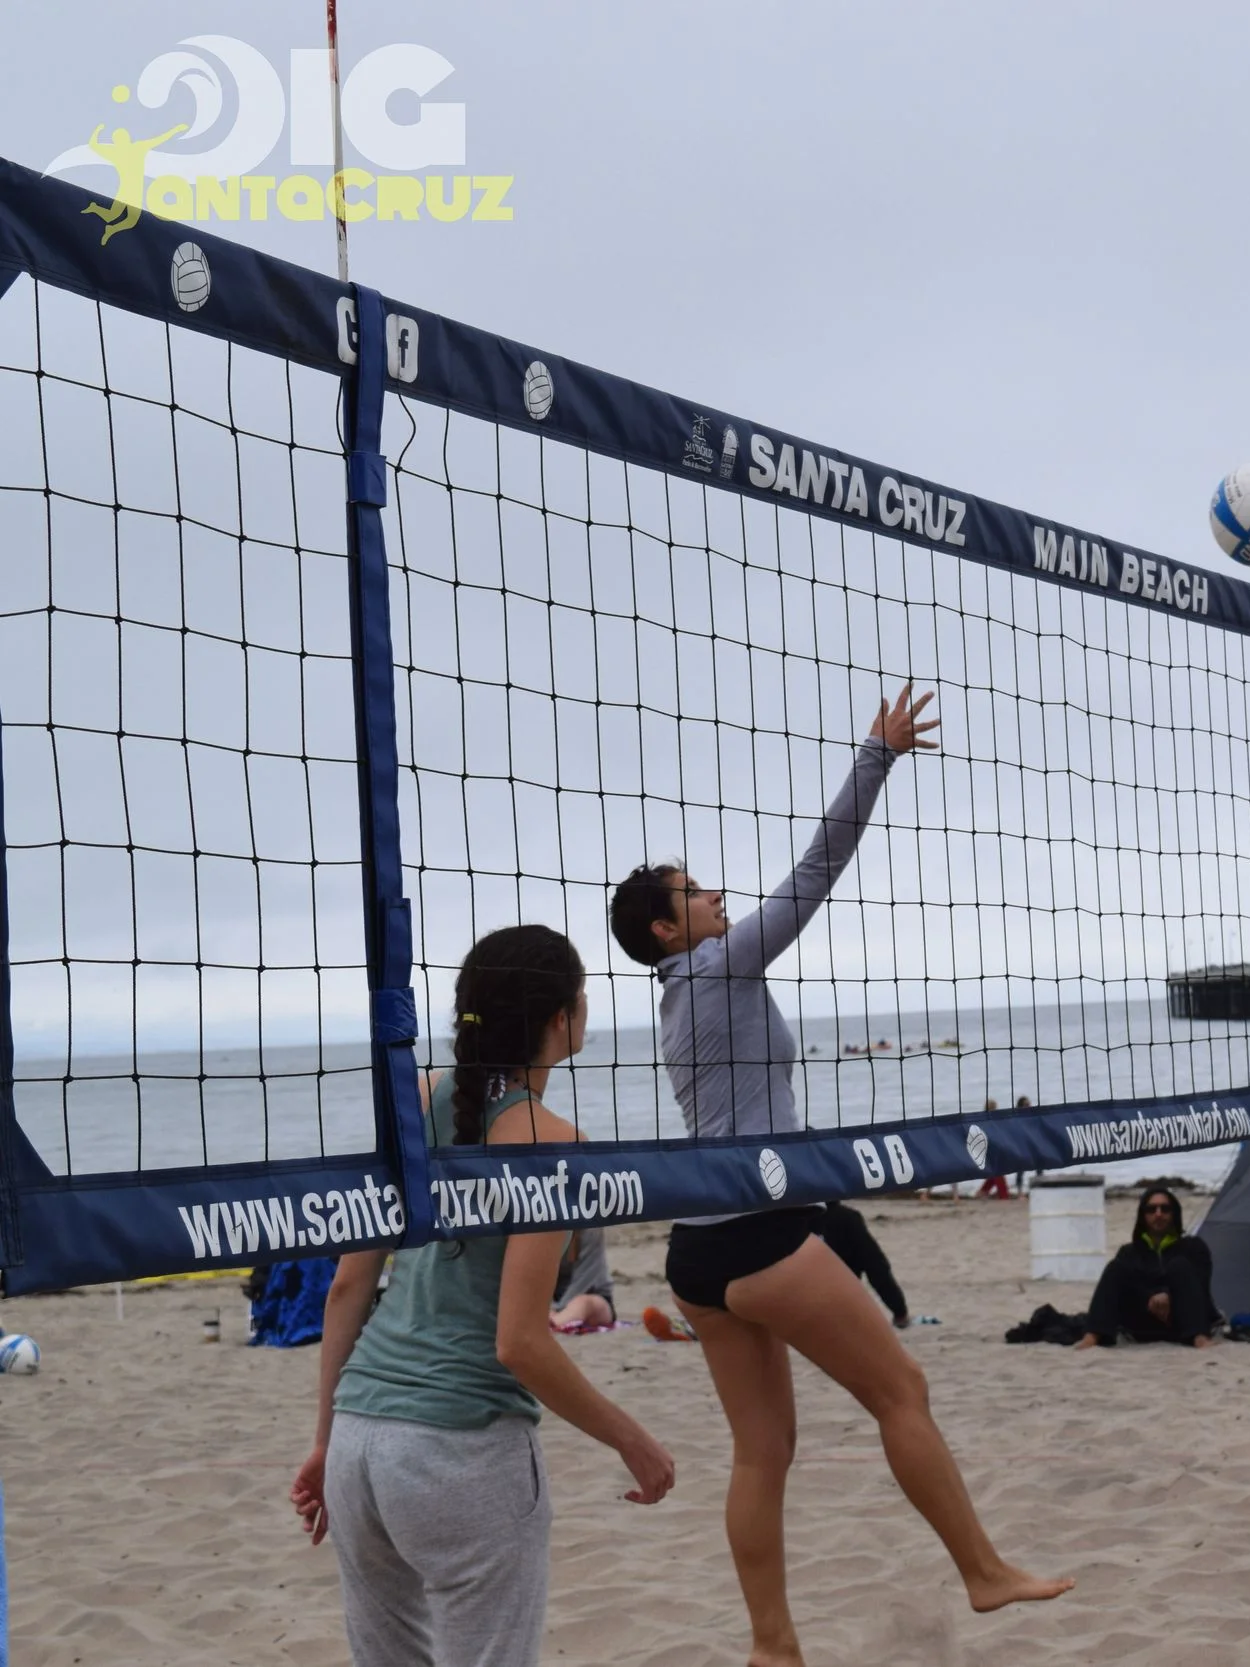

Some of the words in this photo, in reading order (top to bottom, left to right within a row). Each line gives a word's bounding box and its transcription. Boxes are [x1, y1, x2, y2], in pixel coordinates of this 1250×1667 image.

[749, 433, 868, 518] SANTA
[878, 476, 967, 547] CRUZ
[1033, 525, 1109, 587] MAIN
[1119, 552, 1209, 616] BEACH
